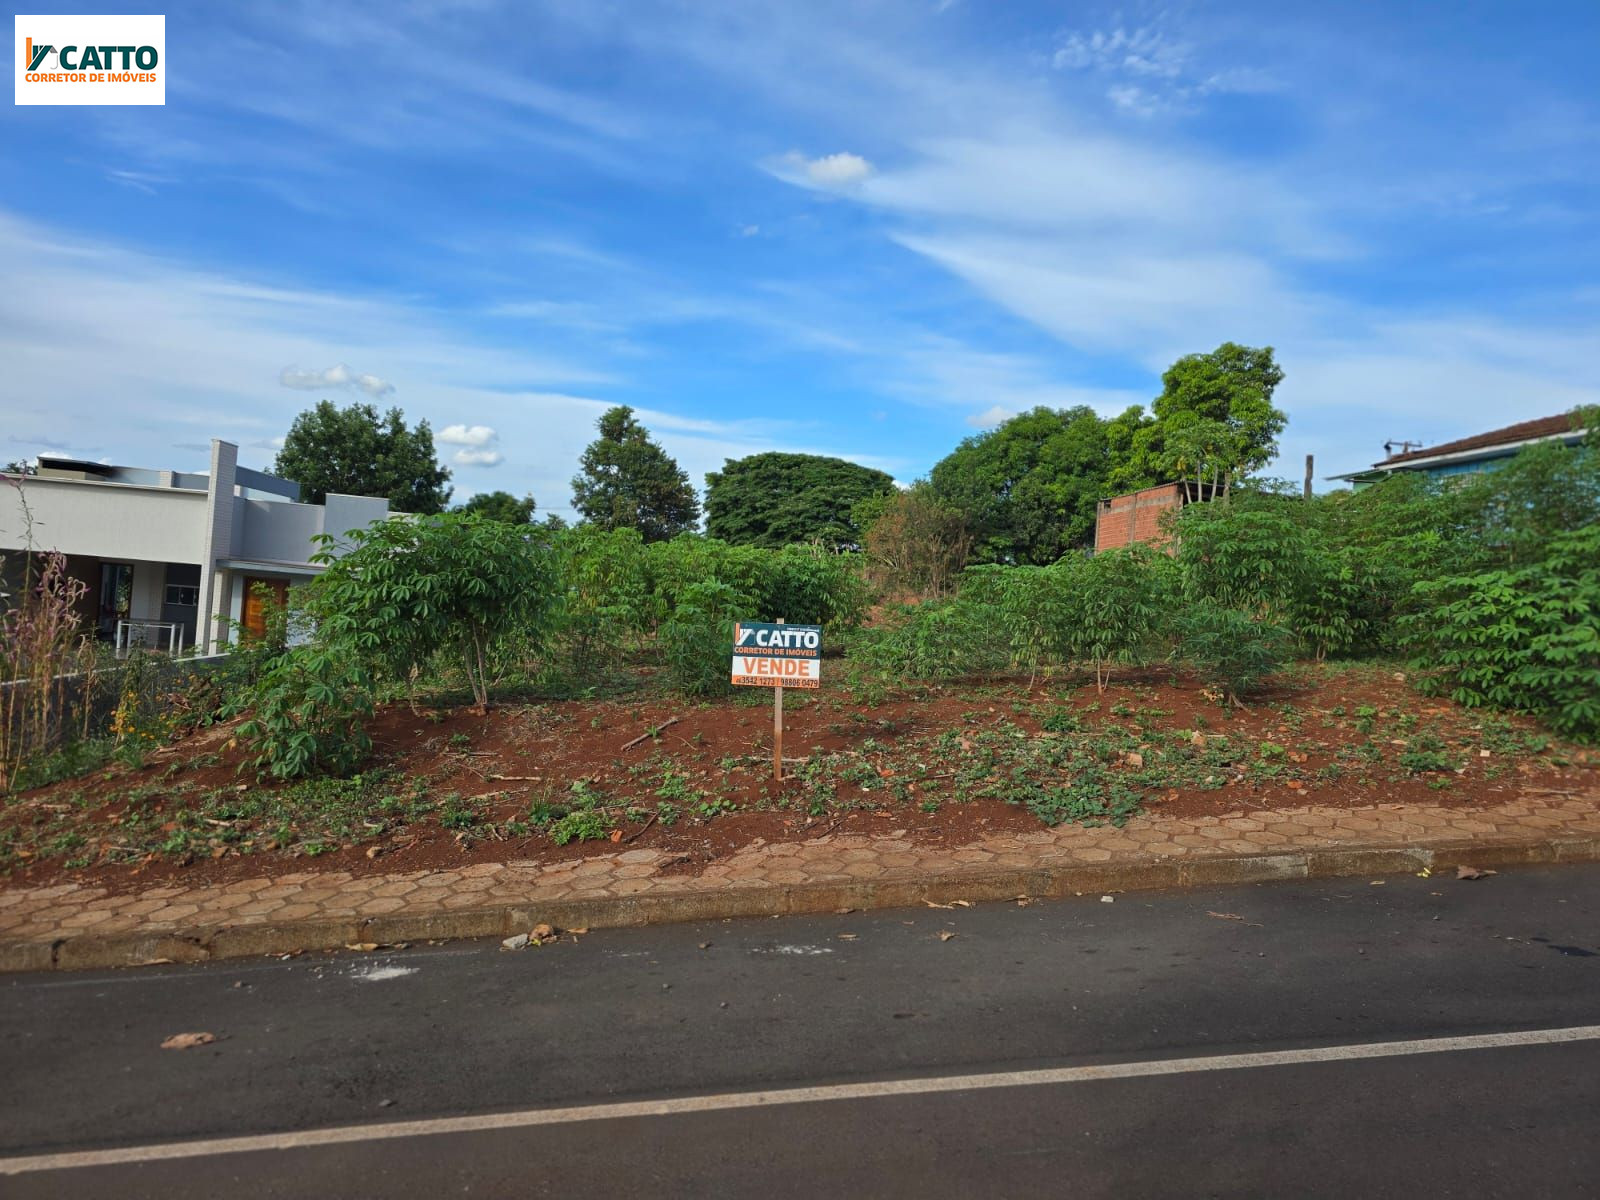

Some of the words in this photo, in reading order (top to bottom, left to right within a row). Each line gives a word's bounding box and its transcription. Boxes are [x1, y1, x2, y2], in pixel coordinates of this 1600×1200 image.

[756, 629, 819, 648] CATTO
[735, 647, 773, 655] CORRETOR
[786, 648, 817, 657] IMÓVEIS
[743, 658, 810, 676] VENDE
